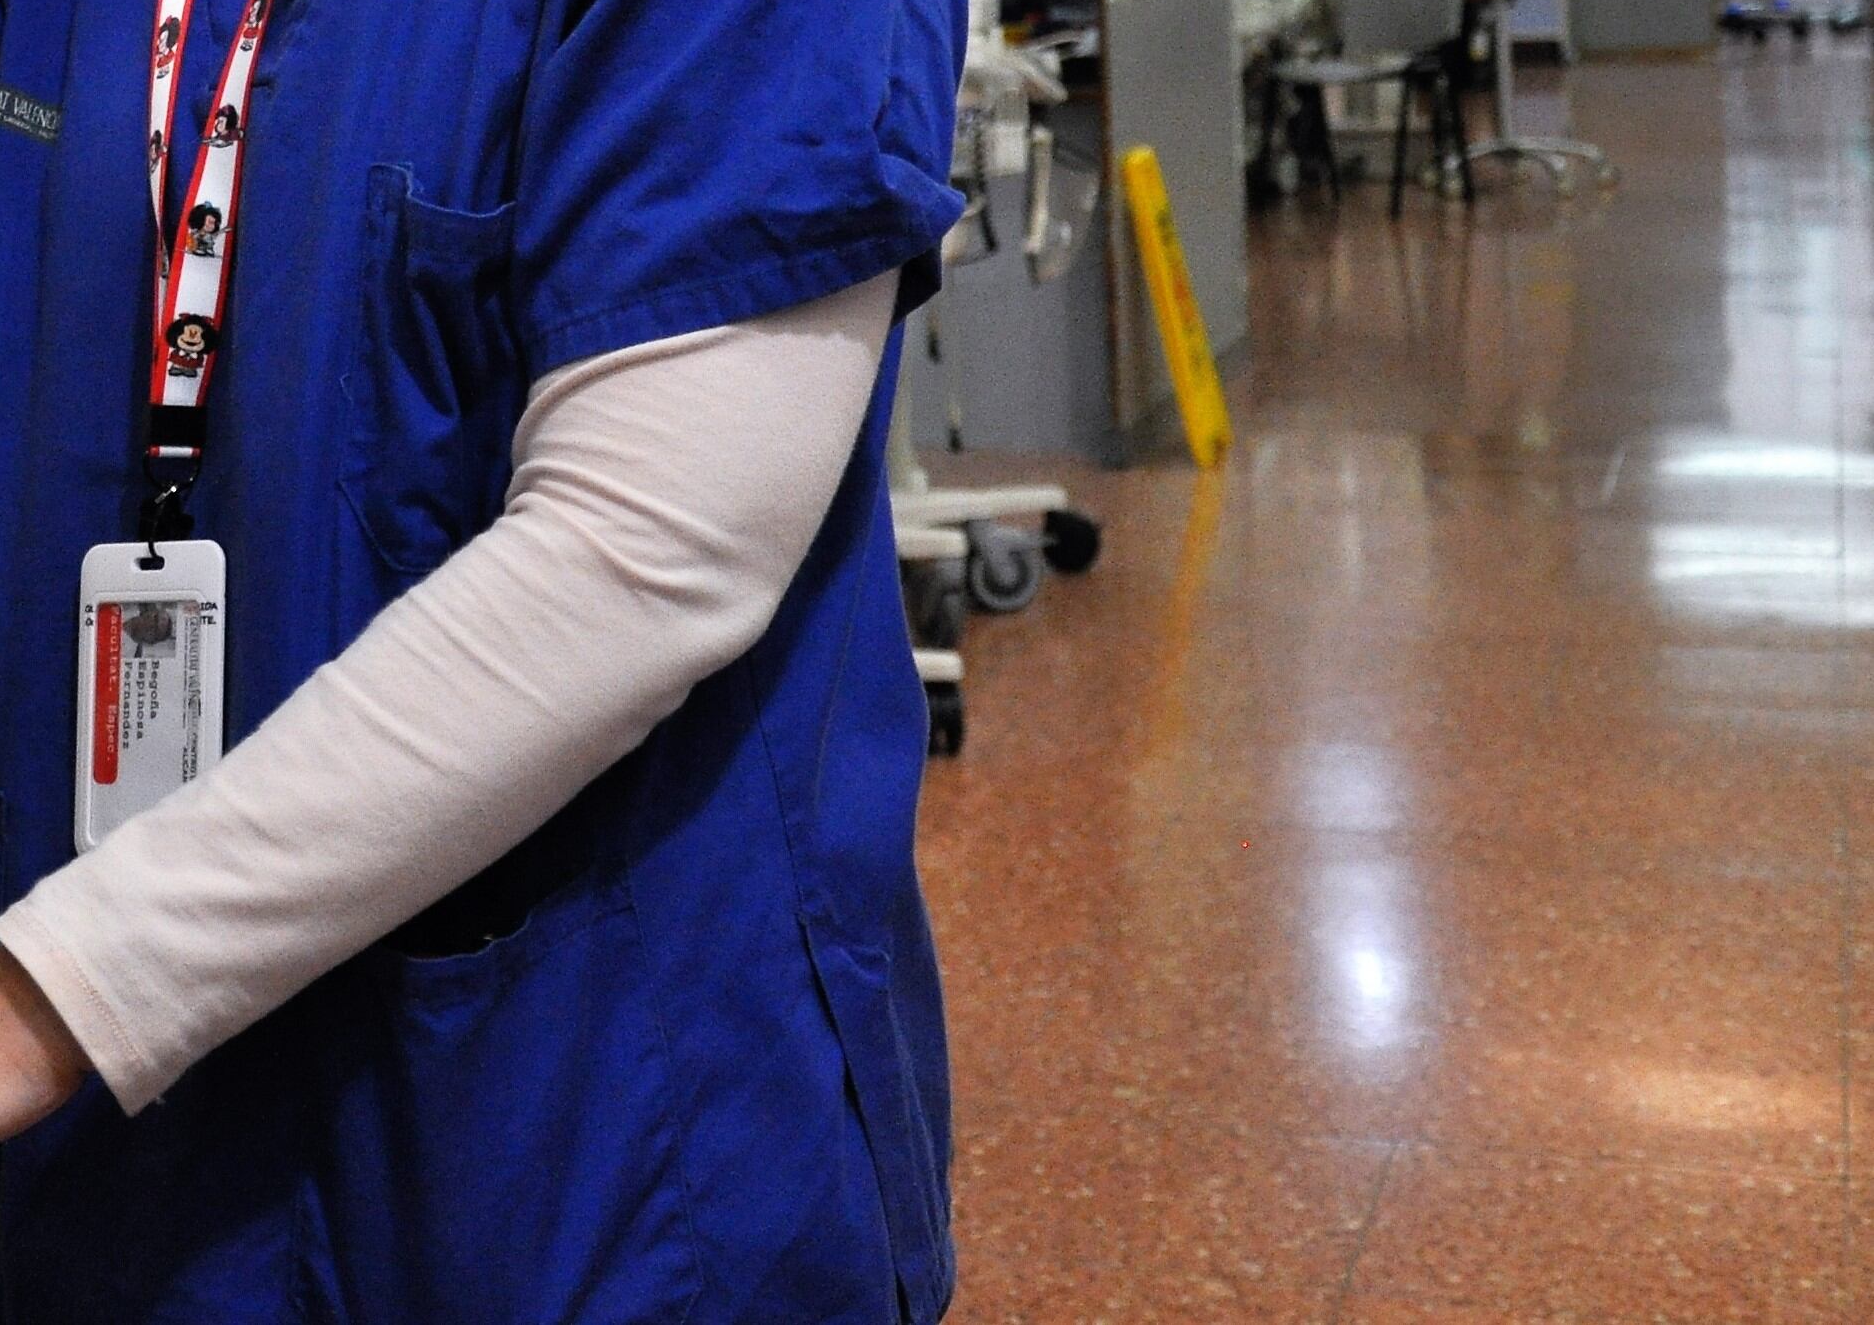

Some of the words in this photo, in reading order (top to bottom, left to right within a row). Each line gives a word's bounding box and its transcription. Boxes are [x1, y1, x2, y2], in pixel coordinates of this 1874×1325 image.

[123, 661, 133, 750] Fernandez
[136, 661, 147, 740] Espinosa
[149, 660, 160, 719] Begoña
